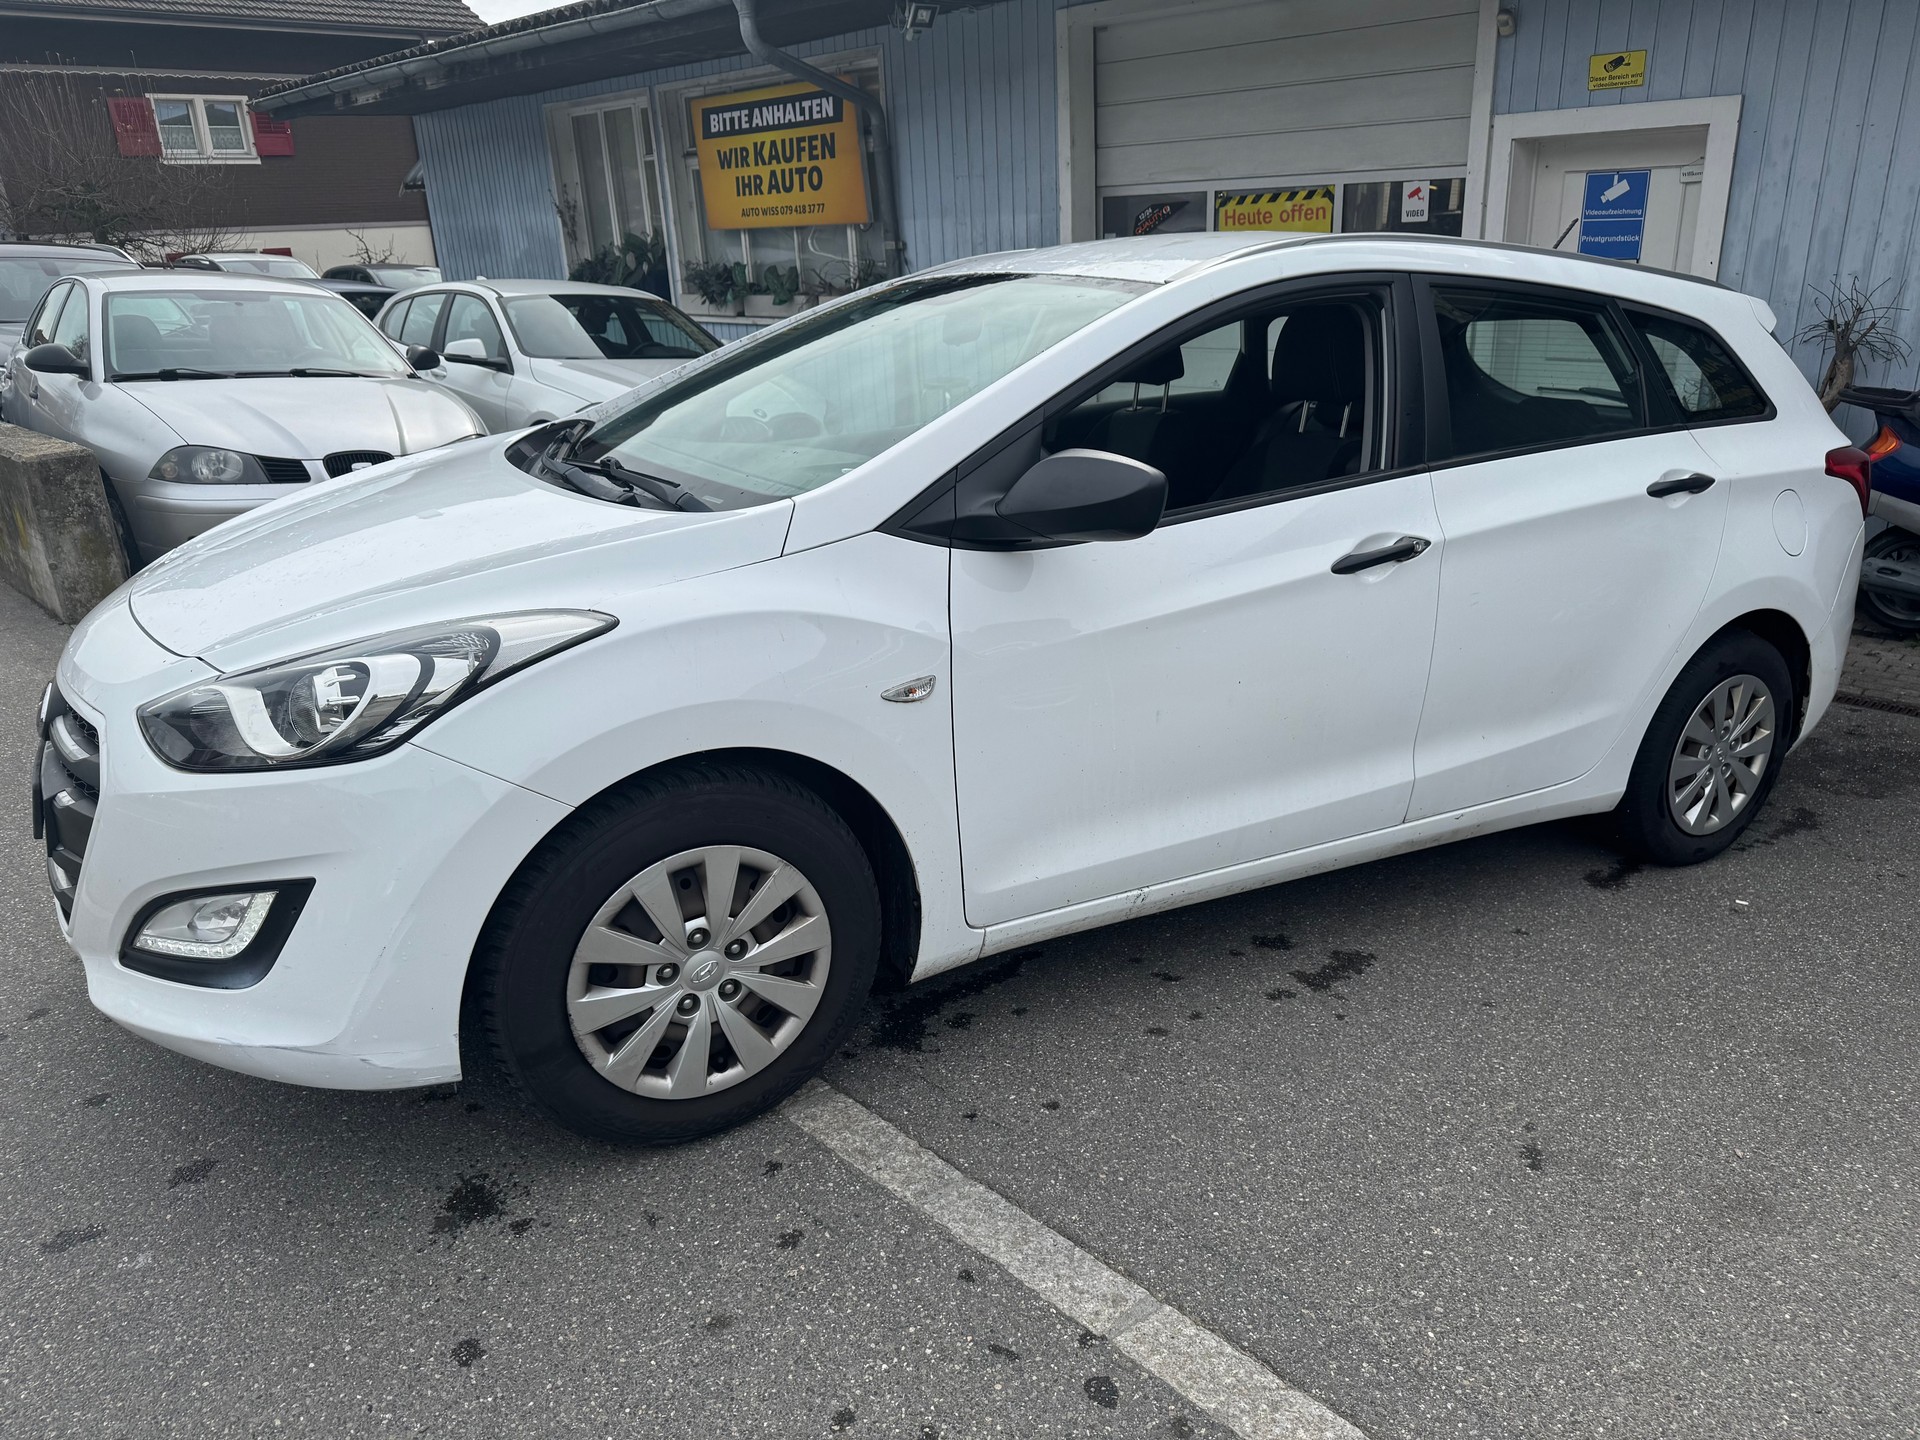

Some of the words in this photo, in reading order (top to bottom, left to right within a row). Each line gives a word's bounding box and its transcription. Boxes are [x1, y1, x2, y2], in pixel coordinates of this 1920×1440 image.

[1608, 73, 1630, 81] Bereich
[709, 108, 750, 133] BITTE
[752, 96, 834, 128] ANHALTEN
[716, 146, 750, 170] WIR
[753, 132, 836, 167] KAUFEN
[735, 174, 764, 197] IHR
[767, 165, 823, 195] AUTO
[741, 207, 760, 218] AUTO
[761, 206, 779, 216] WISS
[780, 205, 793, 215] 079
[794, 204, 807, 215] 418
[808, 203, 816, 214] 37
[817, 203, 825, 213] 77
[1224, 208, 1273, 227] Heute
[1279, 203, 1327, 223] offen
[1405, 209, 1425, 218] VIDEO
[1585, 208, 1642, 216] Videoaufzeichnung
[1135, 210, 1163, 235] QUALITY
[1581, 235, 1640, 244] Privatgrundstück
